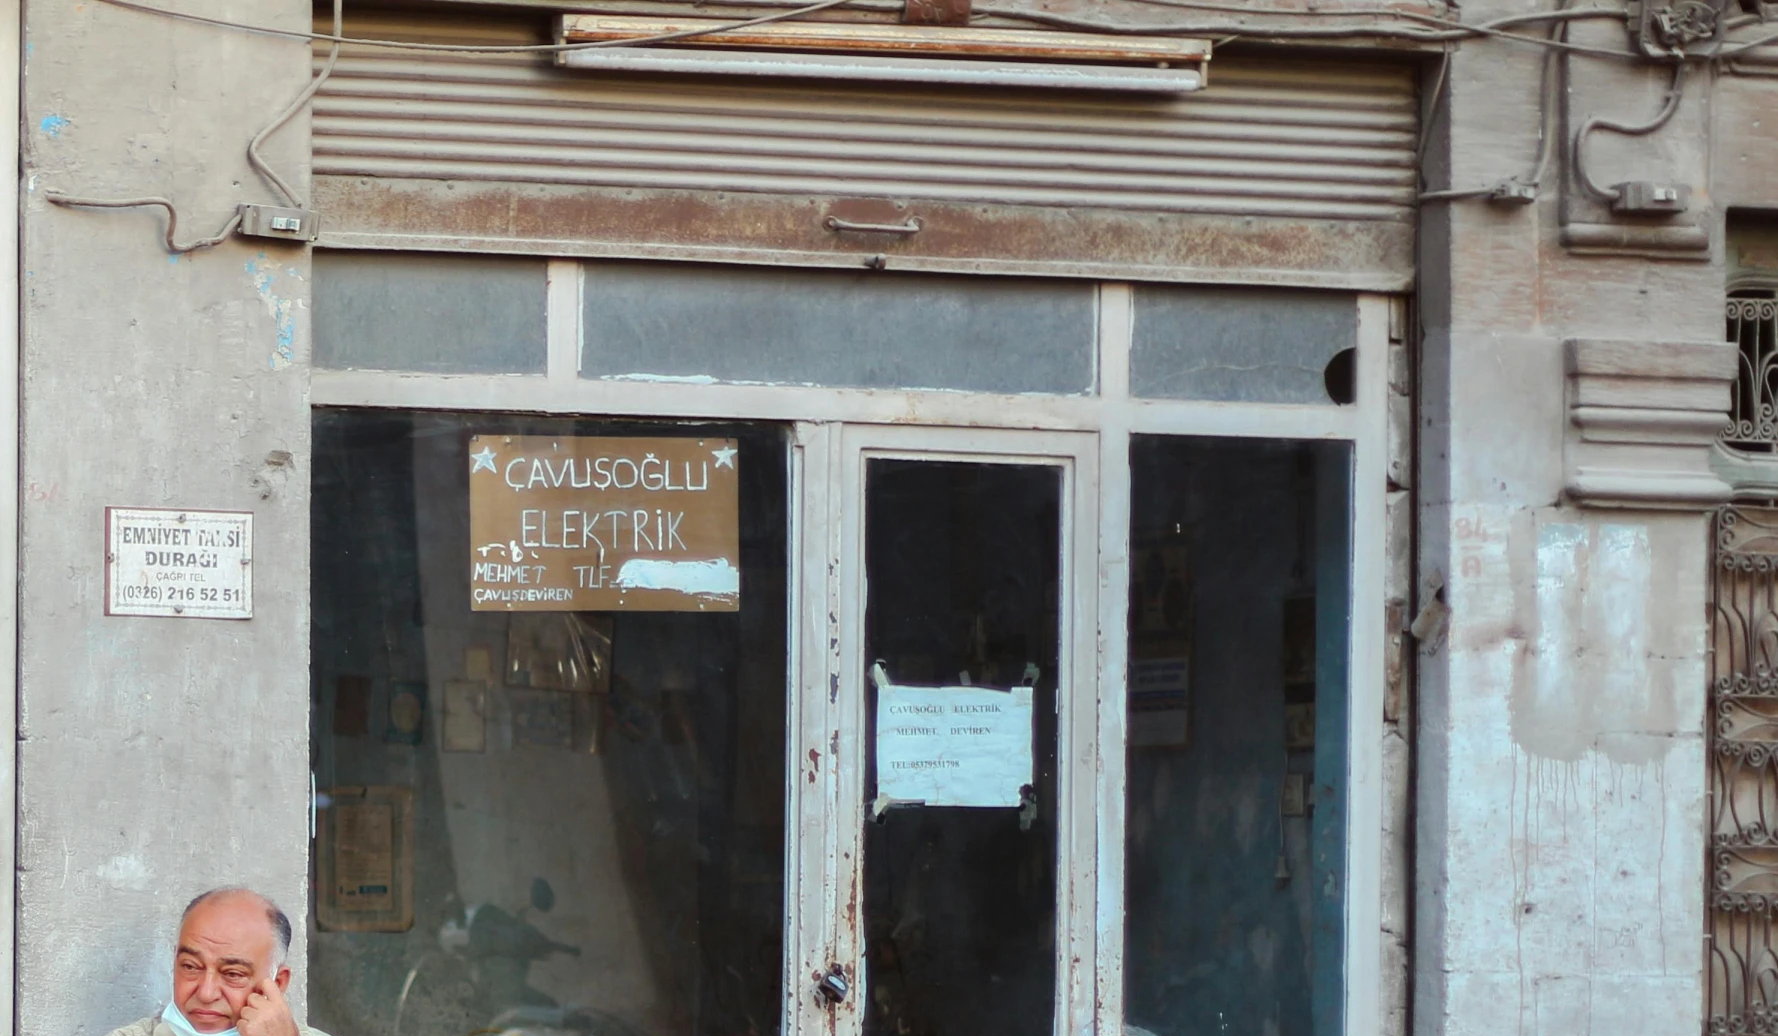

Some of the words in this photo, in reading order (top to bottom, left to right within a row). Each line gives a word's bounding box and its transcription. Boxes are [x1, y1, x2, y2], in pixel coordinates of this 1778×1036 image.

[505, 452, 708, 492] ÇAVUŞOĞLU
[122, 523, 191, 546] EMNİYET
[521, 508, 687, 559] ELEKTRİK
[145, 549, 218, 568] DURAĞI
[156, 571, 187, 583] ÇAĞRI
[189, 573, 206, 583] TEL
[473, 562, 547, 584] MEHMET
[122, 585, 163, 602] (0326)
[167, 586, 195, 601] 216
[200, 587, 218, 601] 52
[223, 588, 240, 602] 51
[889, 704, 945, 714] ÇAVUŞOĞLU
[954, 704, 1002, 713] ELEKTRİK
[896, 728, 937, 736] MEHMET
[950, 726, 991, 735] DEVİREN
